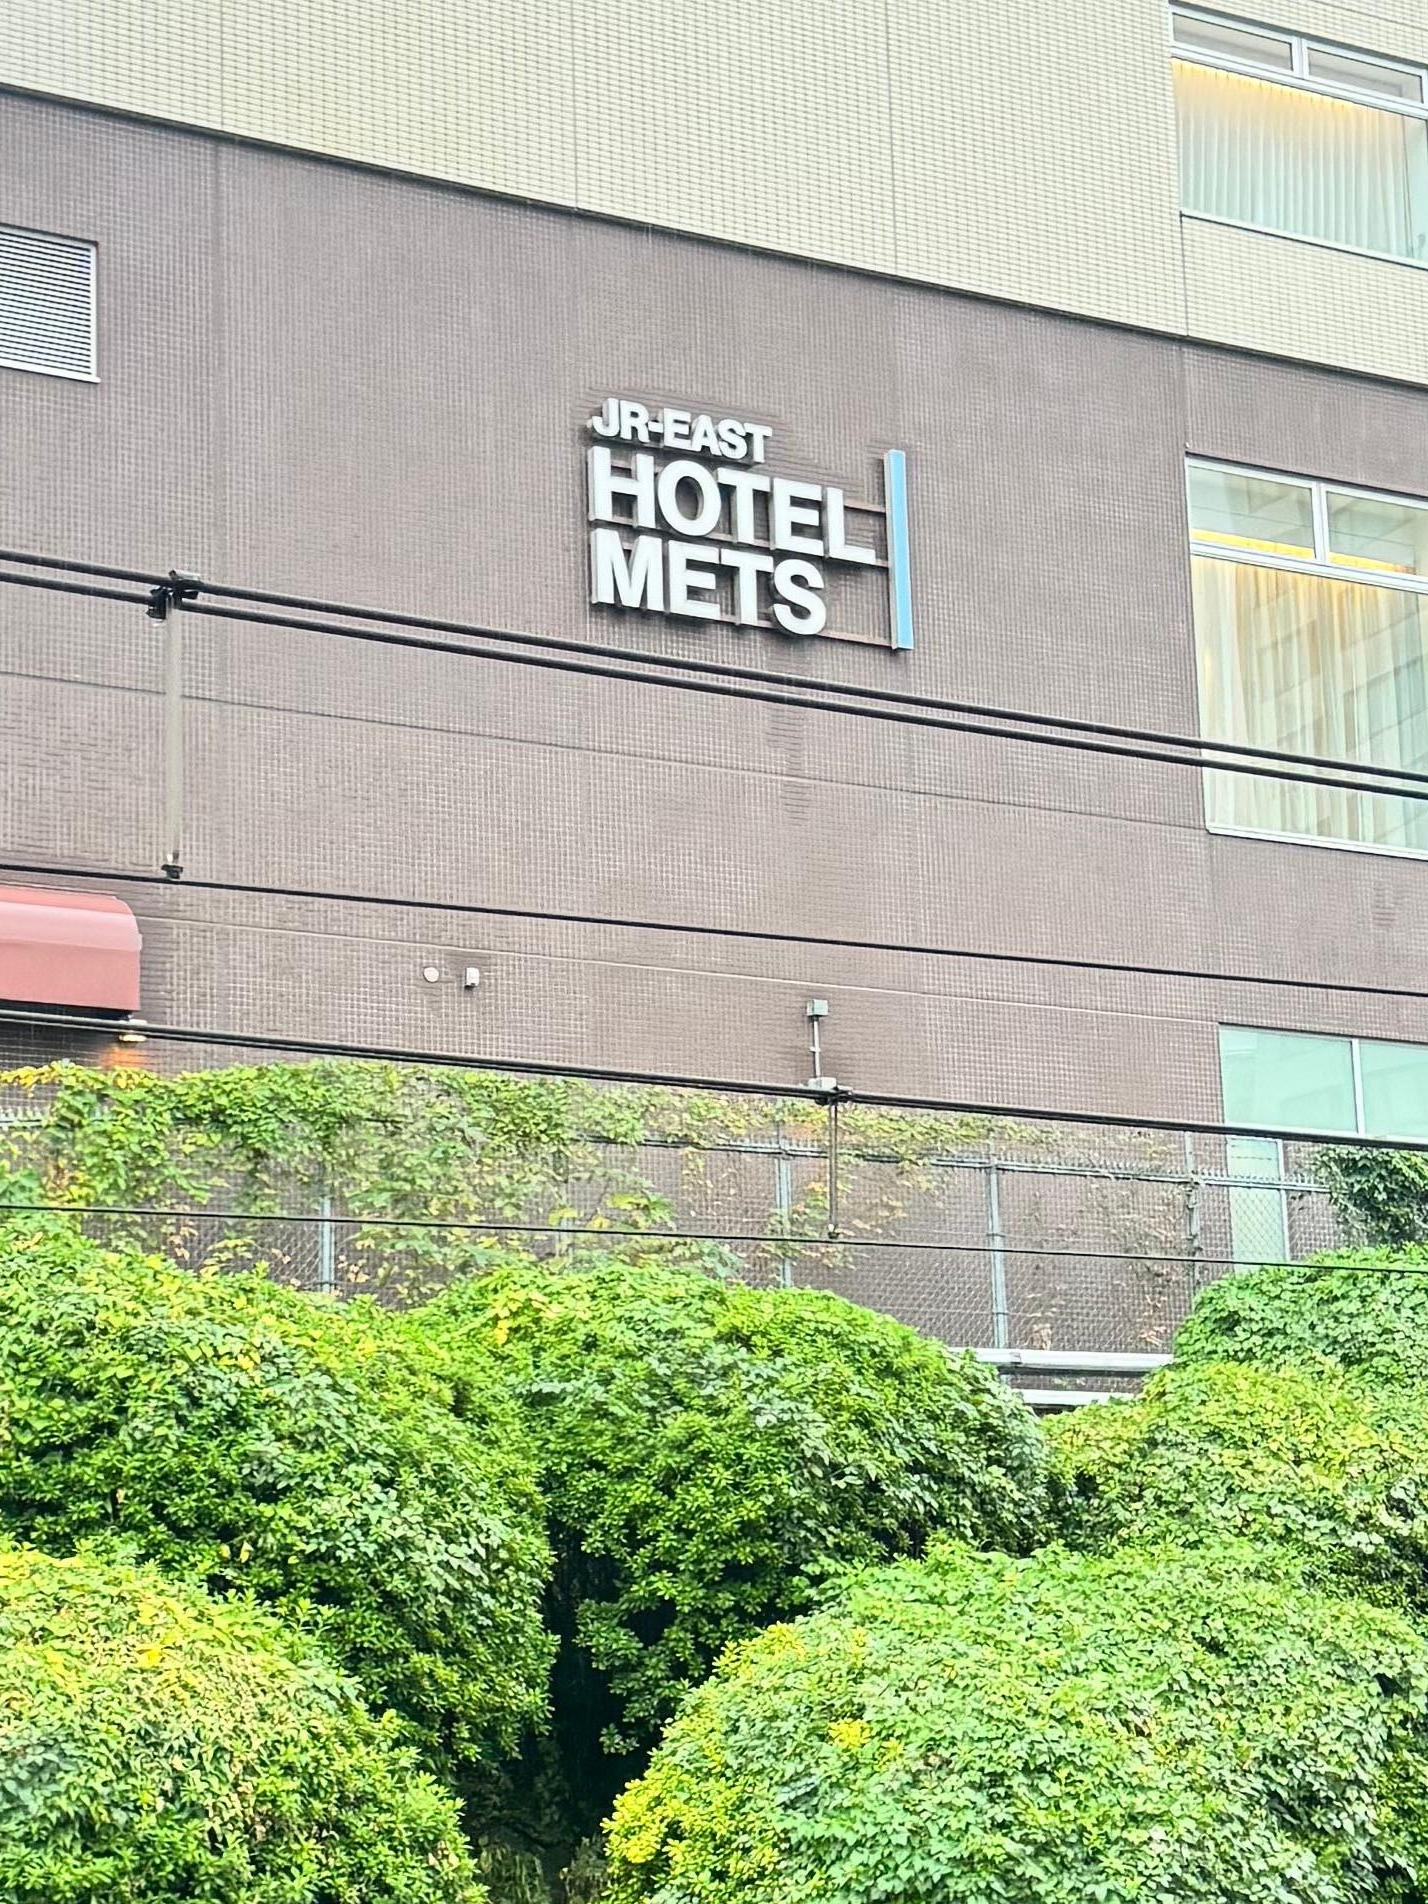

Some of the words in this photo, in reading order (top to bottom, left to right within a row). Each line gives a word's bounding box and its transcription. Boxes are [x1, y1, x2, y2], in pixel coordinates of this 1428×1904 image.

[590, 398, 772, 464] JR-EAST
[588, 446, 876, 565] HOTEL
[590, 528, 827, 635] METS
